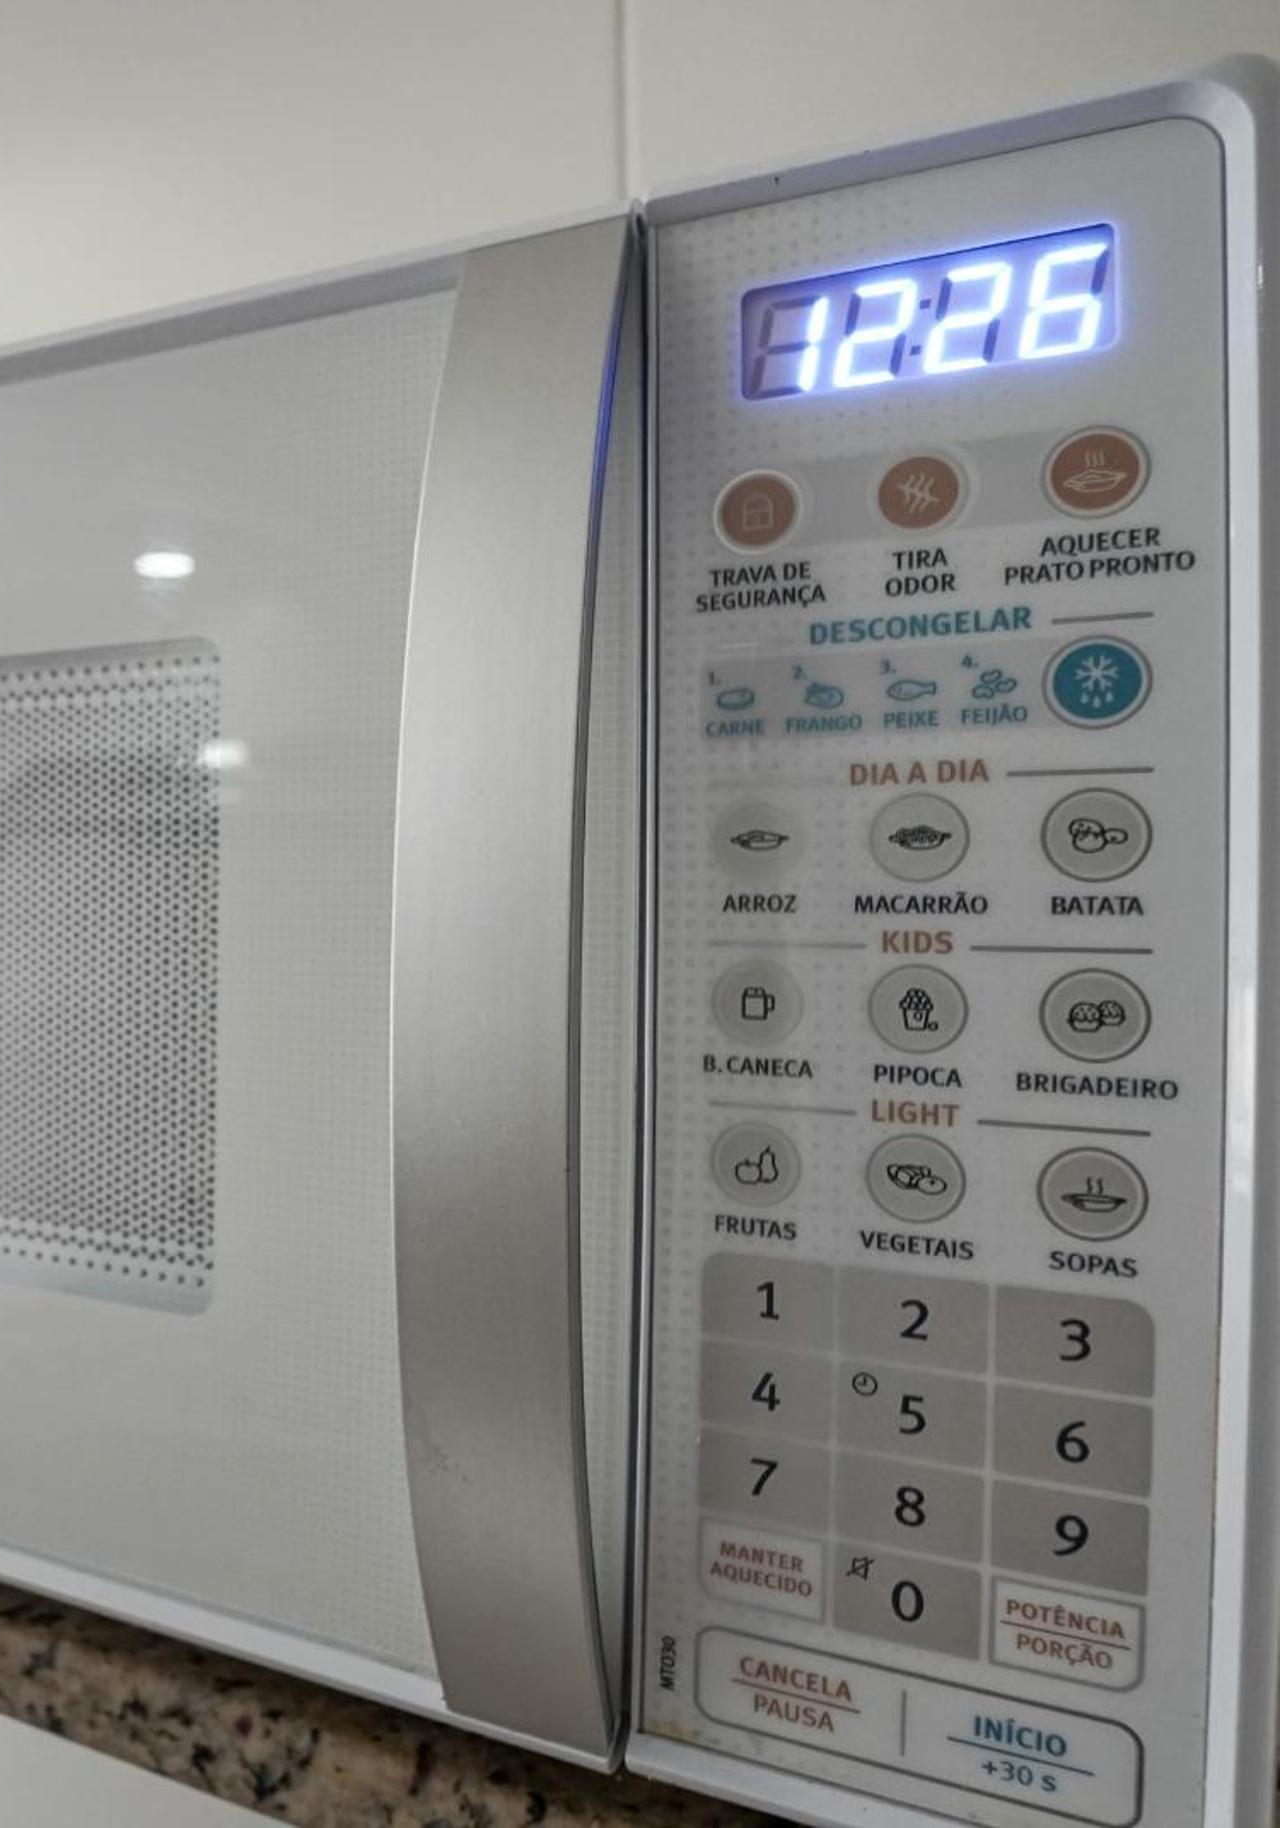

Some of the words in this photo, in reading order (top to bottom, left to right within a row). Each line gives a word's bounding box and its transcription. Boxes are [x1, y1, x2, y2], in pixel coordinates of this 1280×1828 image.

[1040, 526, 1162, 558] AQUECER
[710, 566, 777, 587] TRAVA
[783, 561, 812, 581] DE
[892, 547, 948, 571] TIRA
[1003, 559, 1084, 585] PRATO
[1089, 550, 1196, 580] PRONTO
[695, 583, 827, 614] SEGURANÇA
[884, 573, 956, 597] ODOR
[809, 606, 1033, 646] DESCONGELAR
[792, 665, 808, 682] 2.
[705, 718, 766, 737] CARNE
[785, 714, 862, 733] FRANGO
[883, 710, 940, 729] PEIXE
[960, 704, 1028, 727] FEIJÃO
[849, 762, 899, 786] DIA
[907, 763, 926, 783] A
[937, 759, 989, 783] DIA
[722, 894, 797, 914] ARROZ
[854, 891, 988, 915] MACARRÃO
[1050, 896, 1144, 916] BATATA
[881, 930, 954, 955] KIDS
[873, 1064, 963, 1088] PIPOCA
[1016, 1072, 1179, 1101] BRIGADEIRO
[871, 1100, 960, 1127] LIGHT
[714, 1214, 797, 1240] FRUTAS
[860, 1230, 975, 1261] VEGETAIS
[1048, 1250, 1138, 1279] SOPAS
[756, 1281, 780, 1321] 1
[899, 1299, 930, 1341] 2
[1058, 1318, 1091, 1362] 3
[751, 1372, 780, 1412] 4
[898, 1395, 927, 1435] 5
[1055, 1421, 1091, 1463] 6
[750, 1458, 778, 1497] 7
[894, 1486, 927, 1528] 8
[1053, 1515, 1089, 1556] 9
[719, 1541, 804, 1573] MANTER
[710, 1562, 813, 1599] AQUECIDO
[891, 1580, 925, 1624] 0
[1006, 1597, 1125, 1640] POTÊNCIA
[1016, 1634, 1113, 1671] PORÇÃO
[739, 1656, 853, 1702] CANCELA
[753, 1694, 835, 1732] PAUSA
[974, 1713, 1068, 1758] INÍCIO
[980, 1760, 1033, 1786] +30
